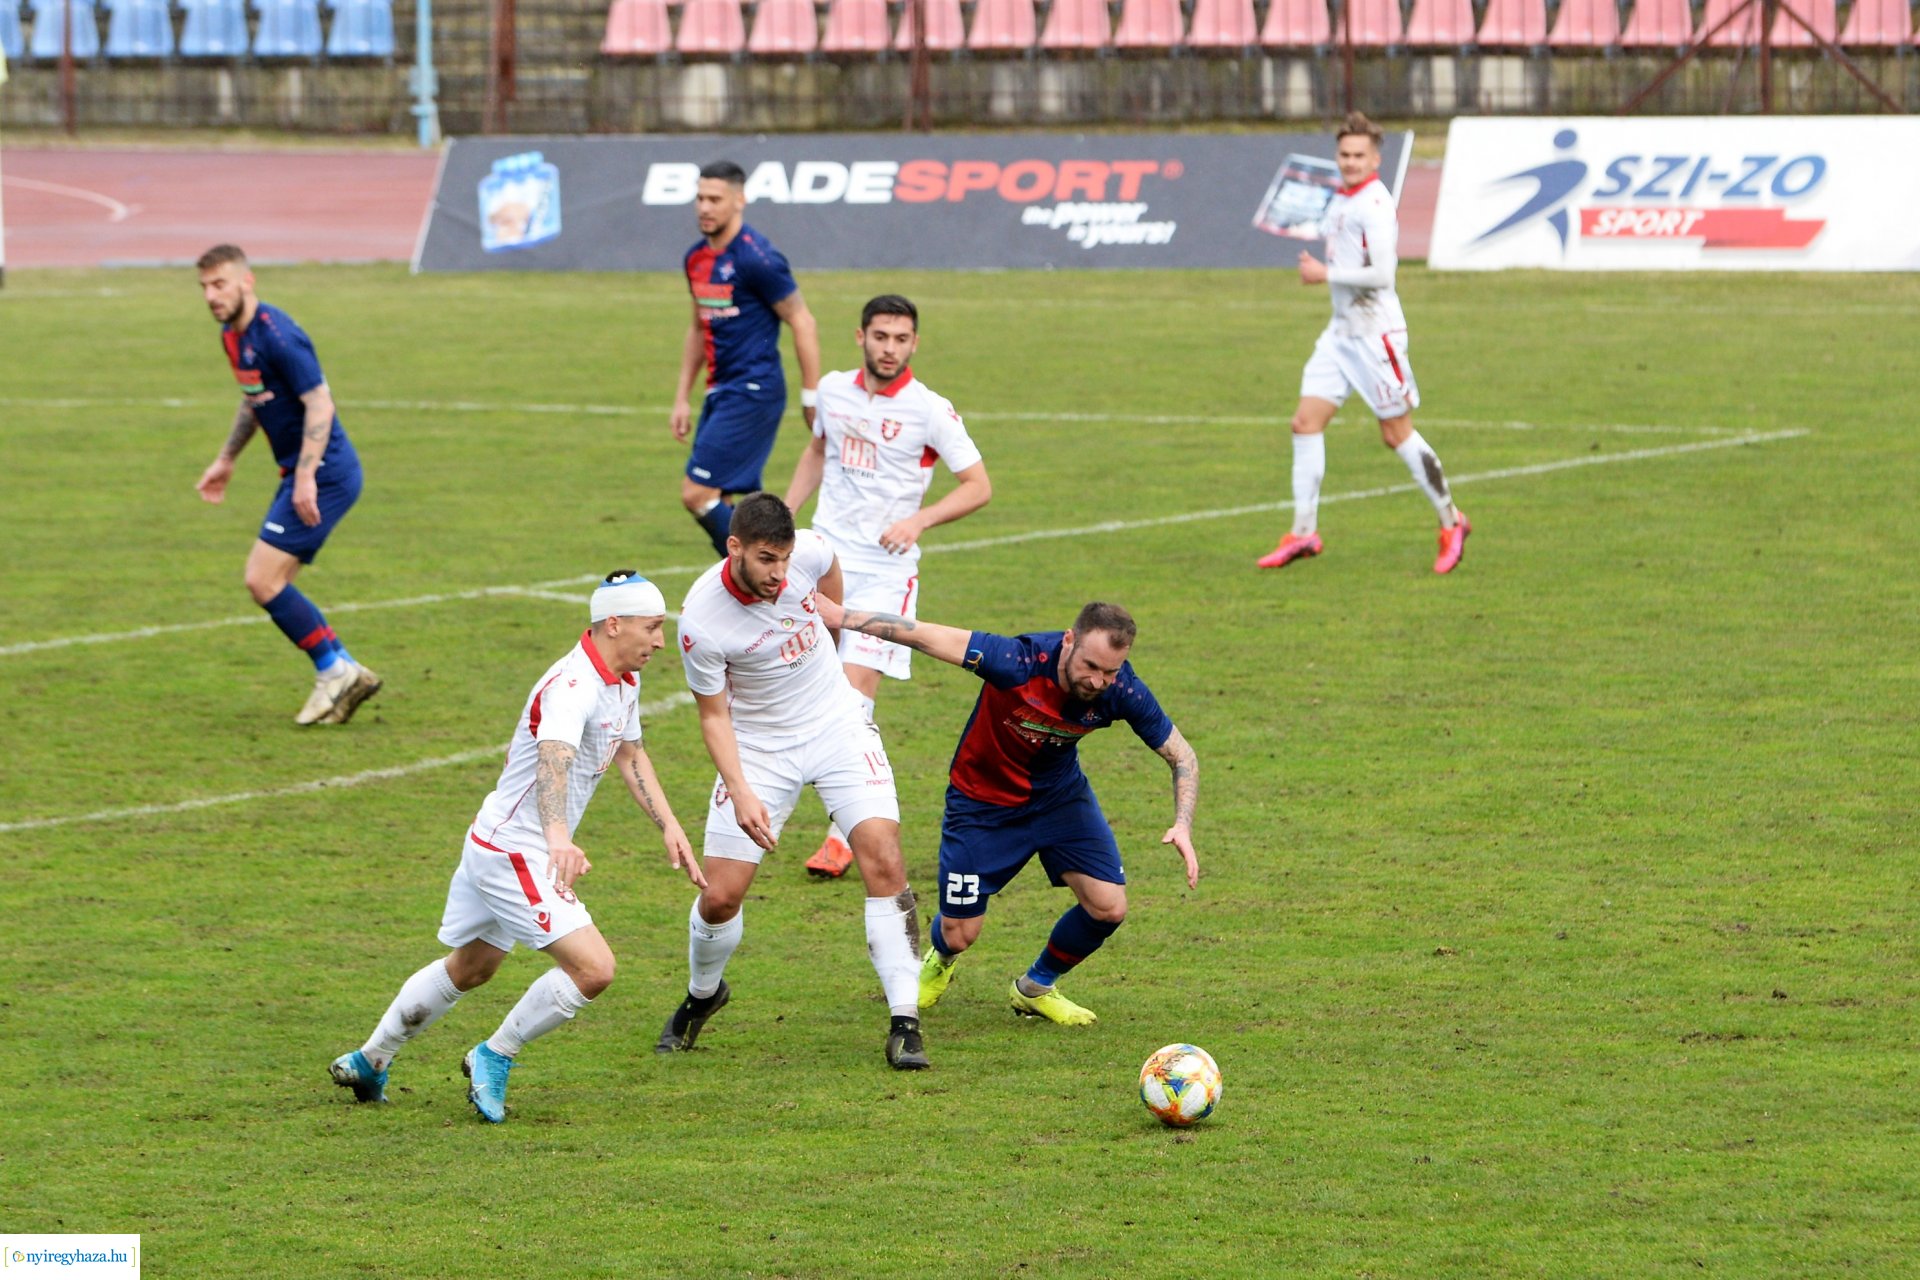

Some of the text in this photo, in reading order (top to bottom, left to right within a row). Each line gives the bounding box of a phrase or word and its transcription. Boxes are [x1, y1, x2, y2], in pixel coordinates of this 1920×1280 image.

[1592, 155, 1828, 198] SZI-ZO
[1591, 208, 1705, 236] SPORT
[946, 873, 979, 905] 23
